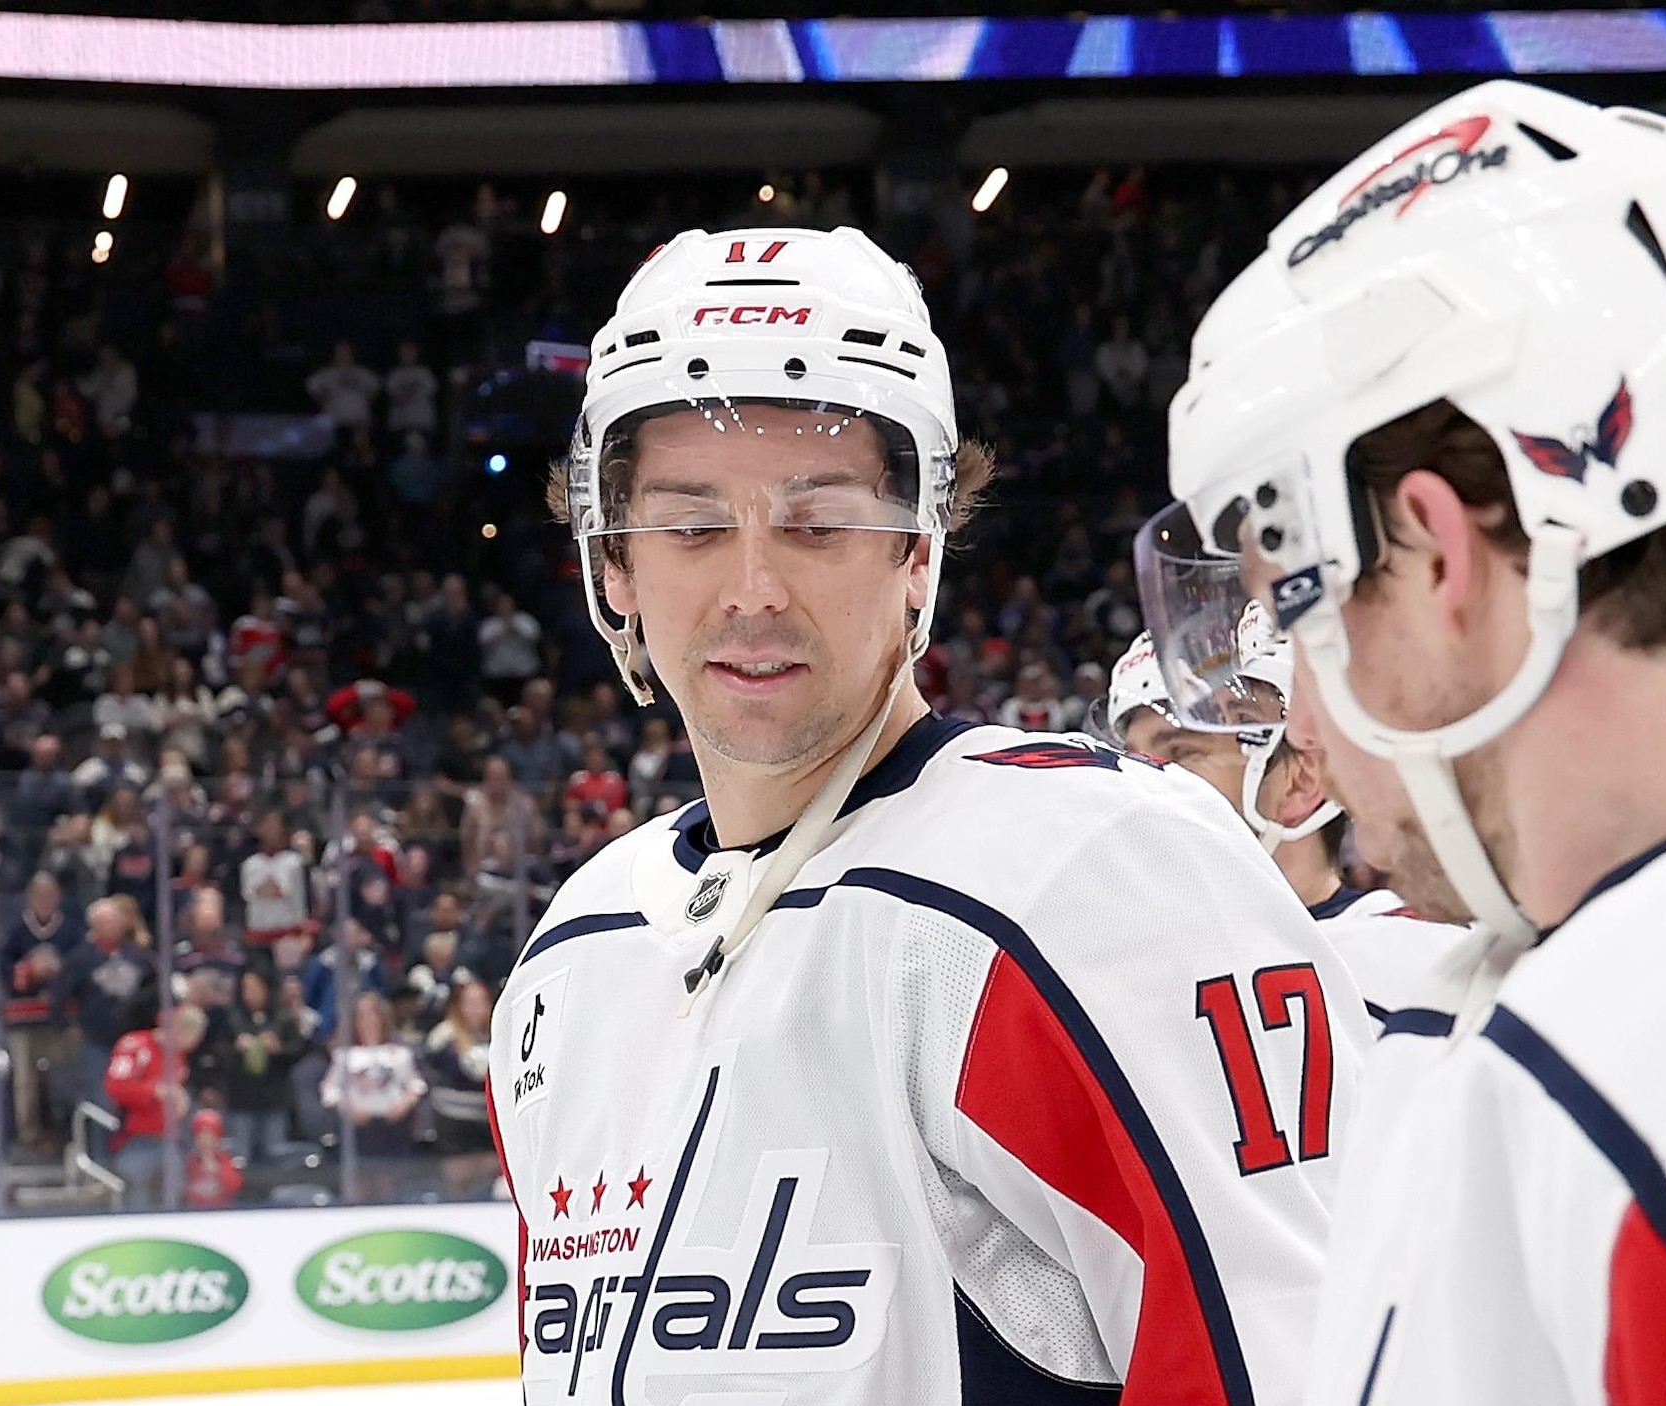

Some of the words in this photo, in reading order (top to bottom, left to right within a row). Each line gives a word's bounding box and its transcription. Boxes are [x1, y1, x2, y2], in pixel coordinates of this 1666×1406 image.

[725, 240, 790, 264] 17
[693, 306, 812, 326] CCM
[1195, 962, 1333, 1177] 17
